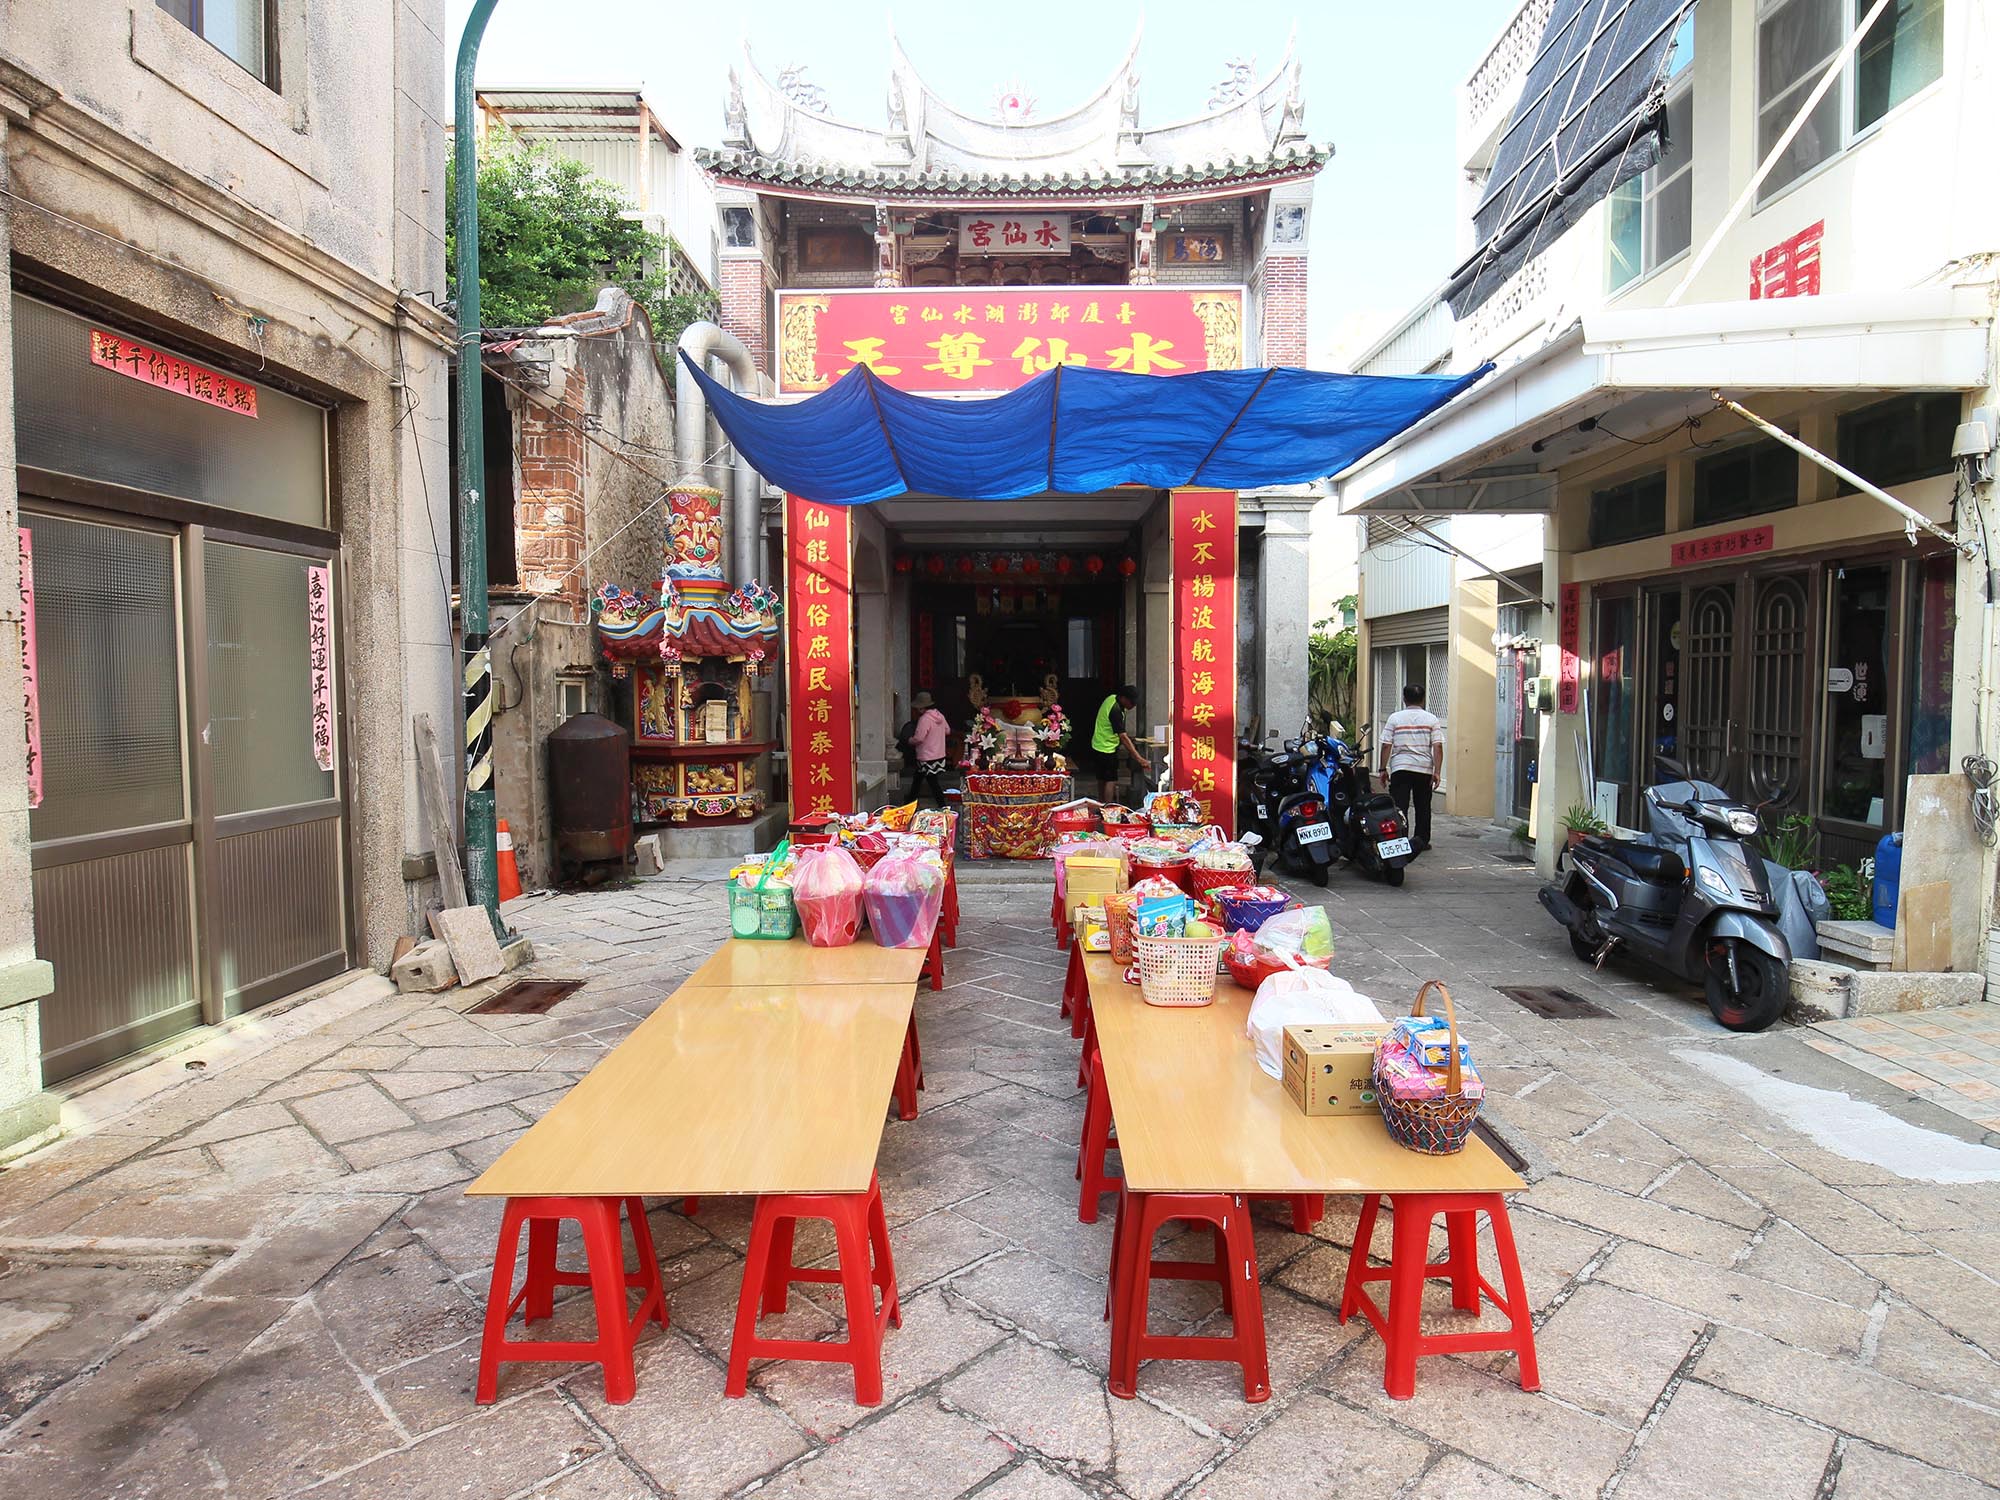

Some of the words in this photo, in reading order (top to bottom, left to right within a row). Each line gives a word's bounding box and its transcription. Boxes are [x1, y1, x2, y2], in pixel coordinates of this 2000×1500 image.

[967, 219, 1062, 247] 水仙宮
[100, 337, 251, 412] 瑞氣臨門納千祥
[835, 331, 1187, 380] 水仙尊王
[309, 570, 330, 747] 喜迎好運平安福
